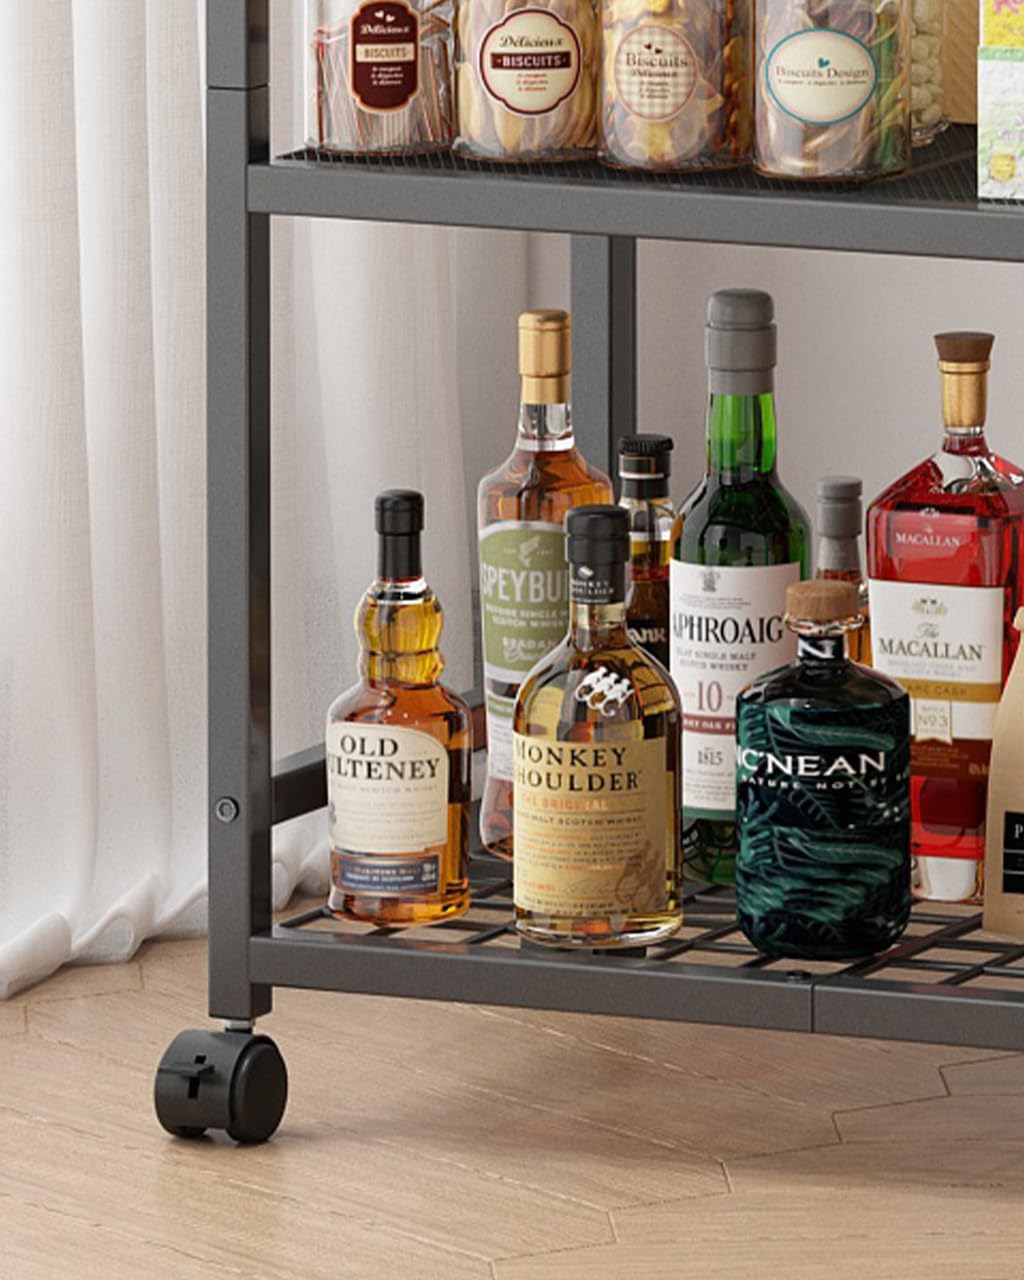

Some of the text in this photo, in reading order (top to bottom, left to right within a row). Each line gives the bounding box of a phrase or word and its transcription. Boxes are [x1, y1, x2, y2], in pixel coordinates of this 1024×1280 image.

[364, 46, 408, 58] BISCUITS
[625, 51, 688, 68] Biscuits
[502, 55, 561, 67] BISCUITS
[776, 65, 870, 80] Biscuits Design
[895, 532, 960, 547] MACALLAN
[879, 638, 985, 661] MACALLAN
[697, 680, 723, 713] 10
[340, 734, 399, 757] OLD
